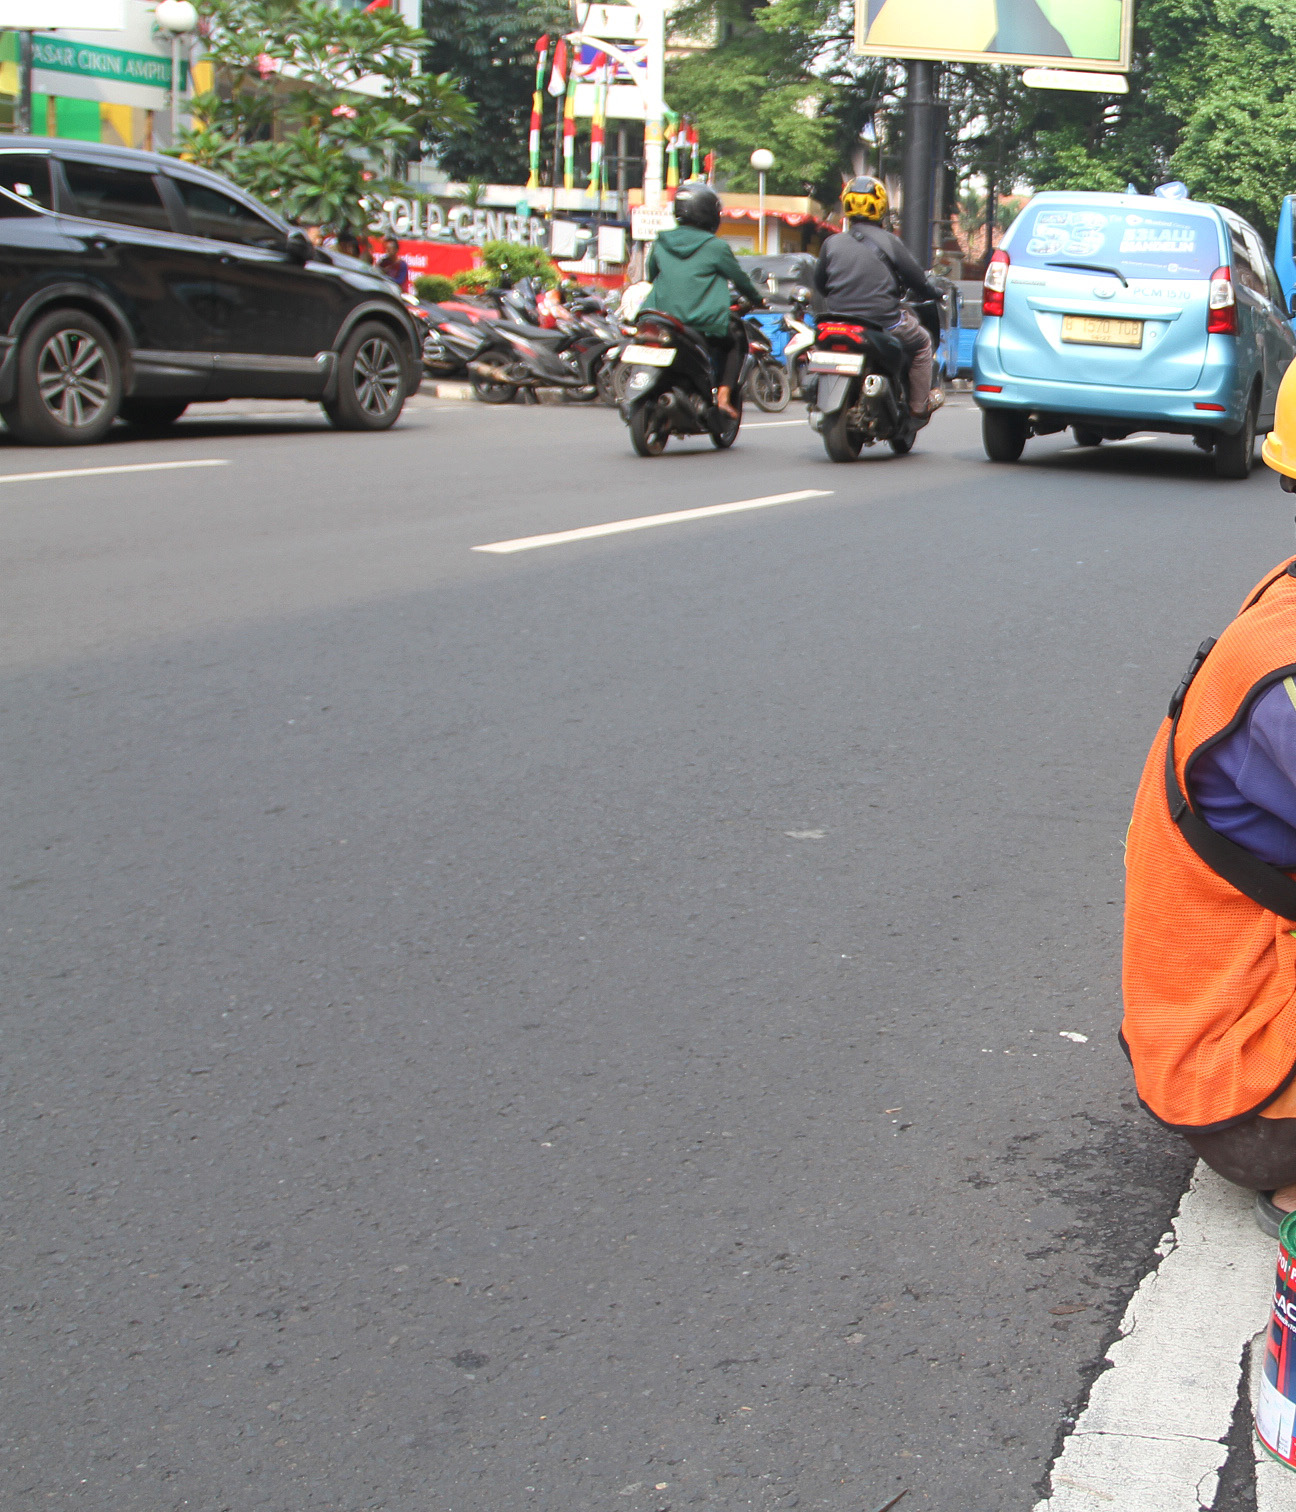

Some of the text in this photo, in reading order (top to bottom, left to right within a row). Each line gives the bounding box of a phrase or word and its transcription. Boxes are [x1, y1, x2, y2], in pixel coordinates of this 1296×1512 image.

[32, 43, 75, 67] ASAR
[77, 49, 122, 75] CIKINI
[453, 204, 544, 249] CENTER
[1133, 287, 1191, 300] PCM 1570
[1065, 317, 1073, 331] B
[1083, 318, 1110, 334] 1570
